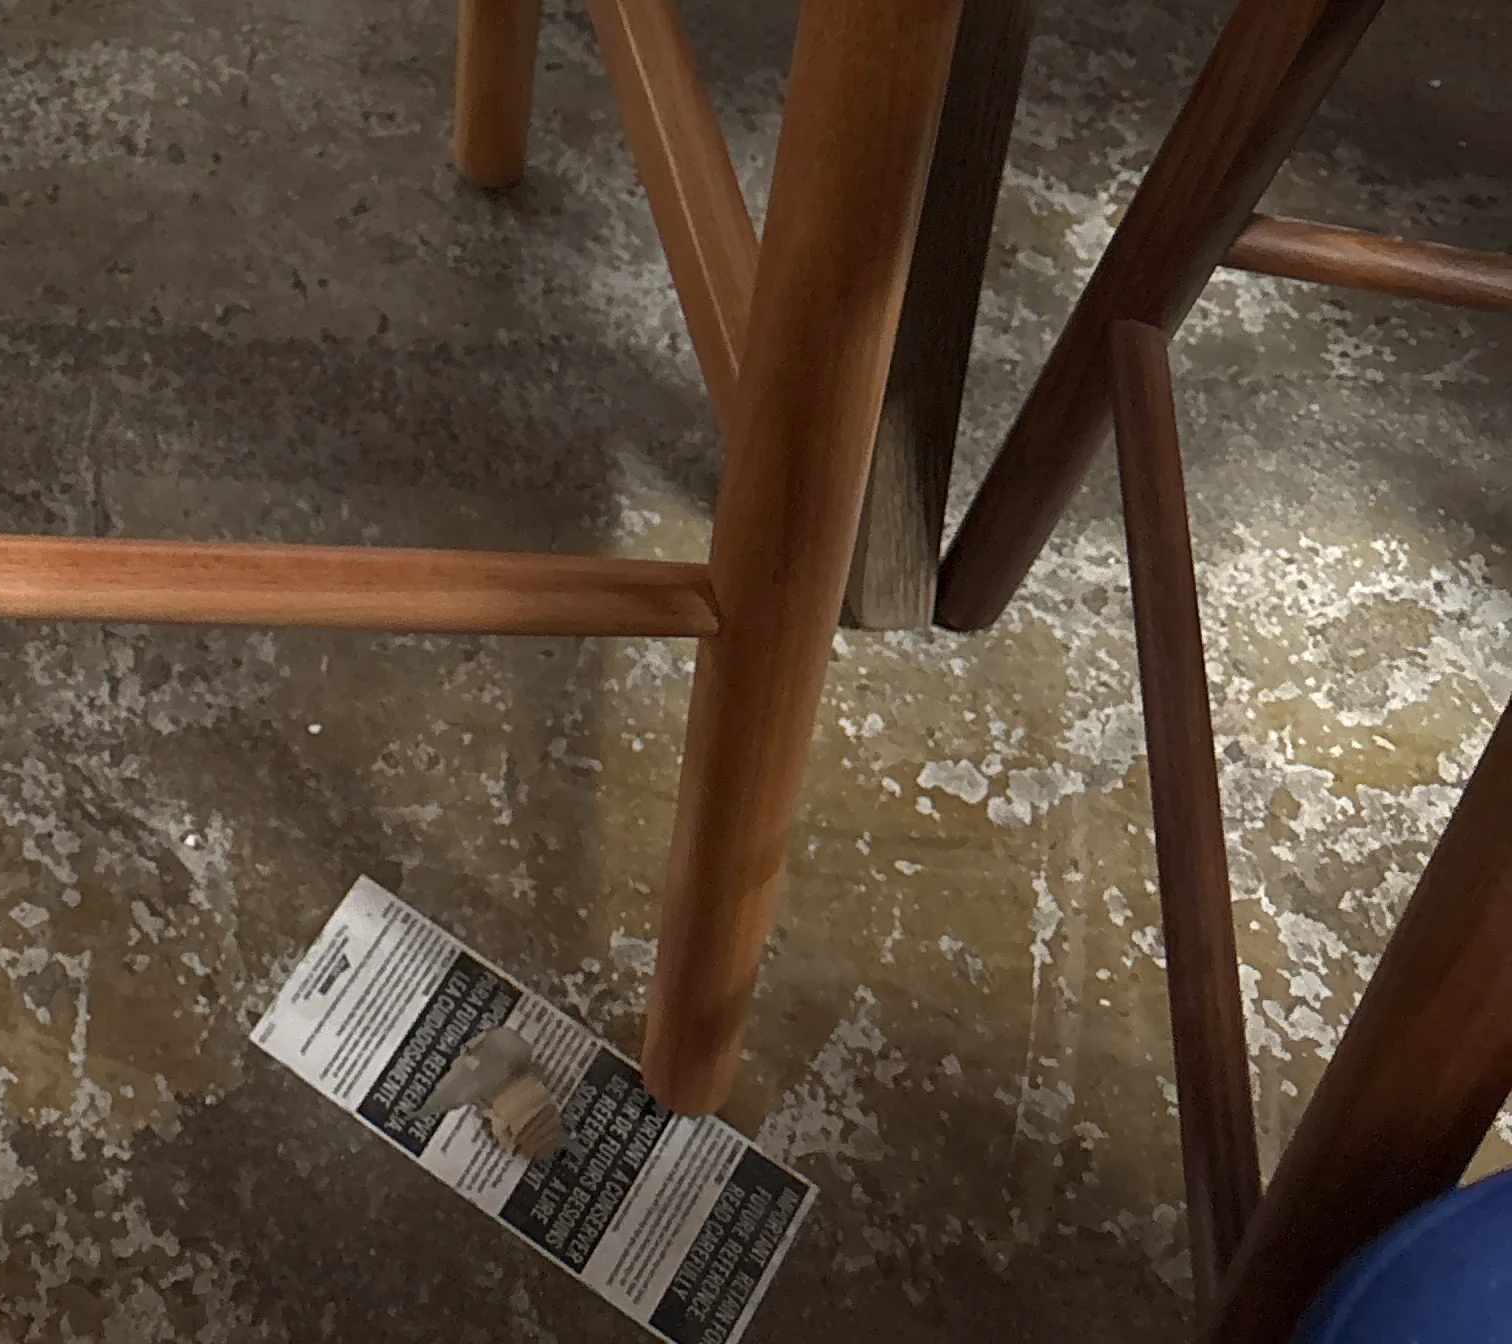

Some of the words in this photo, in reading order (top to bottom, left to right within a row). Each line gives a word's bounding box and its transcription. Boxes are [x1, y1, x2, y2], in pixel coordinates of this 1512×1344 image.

[444, 969, 472, 999] LEA
[434, 1001, 478, 1057] FUTURA
[577, 1134, 621, 1192] FUTURS
[528, 1187, 561, 1225] LIRE
[543, 1186, 591, 1250] BESOINS
[564, 1179, 624, 1265] CONSERVER
[711, 1181, 746, 1224] READ
[730, 1184, 774, 1244] FUTURE
[671, 1218, 725, 1300] CAREFULLY
[714, 1270, 754, 1325] RETAIN
